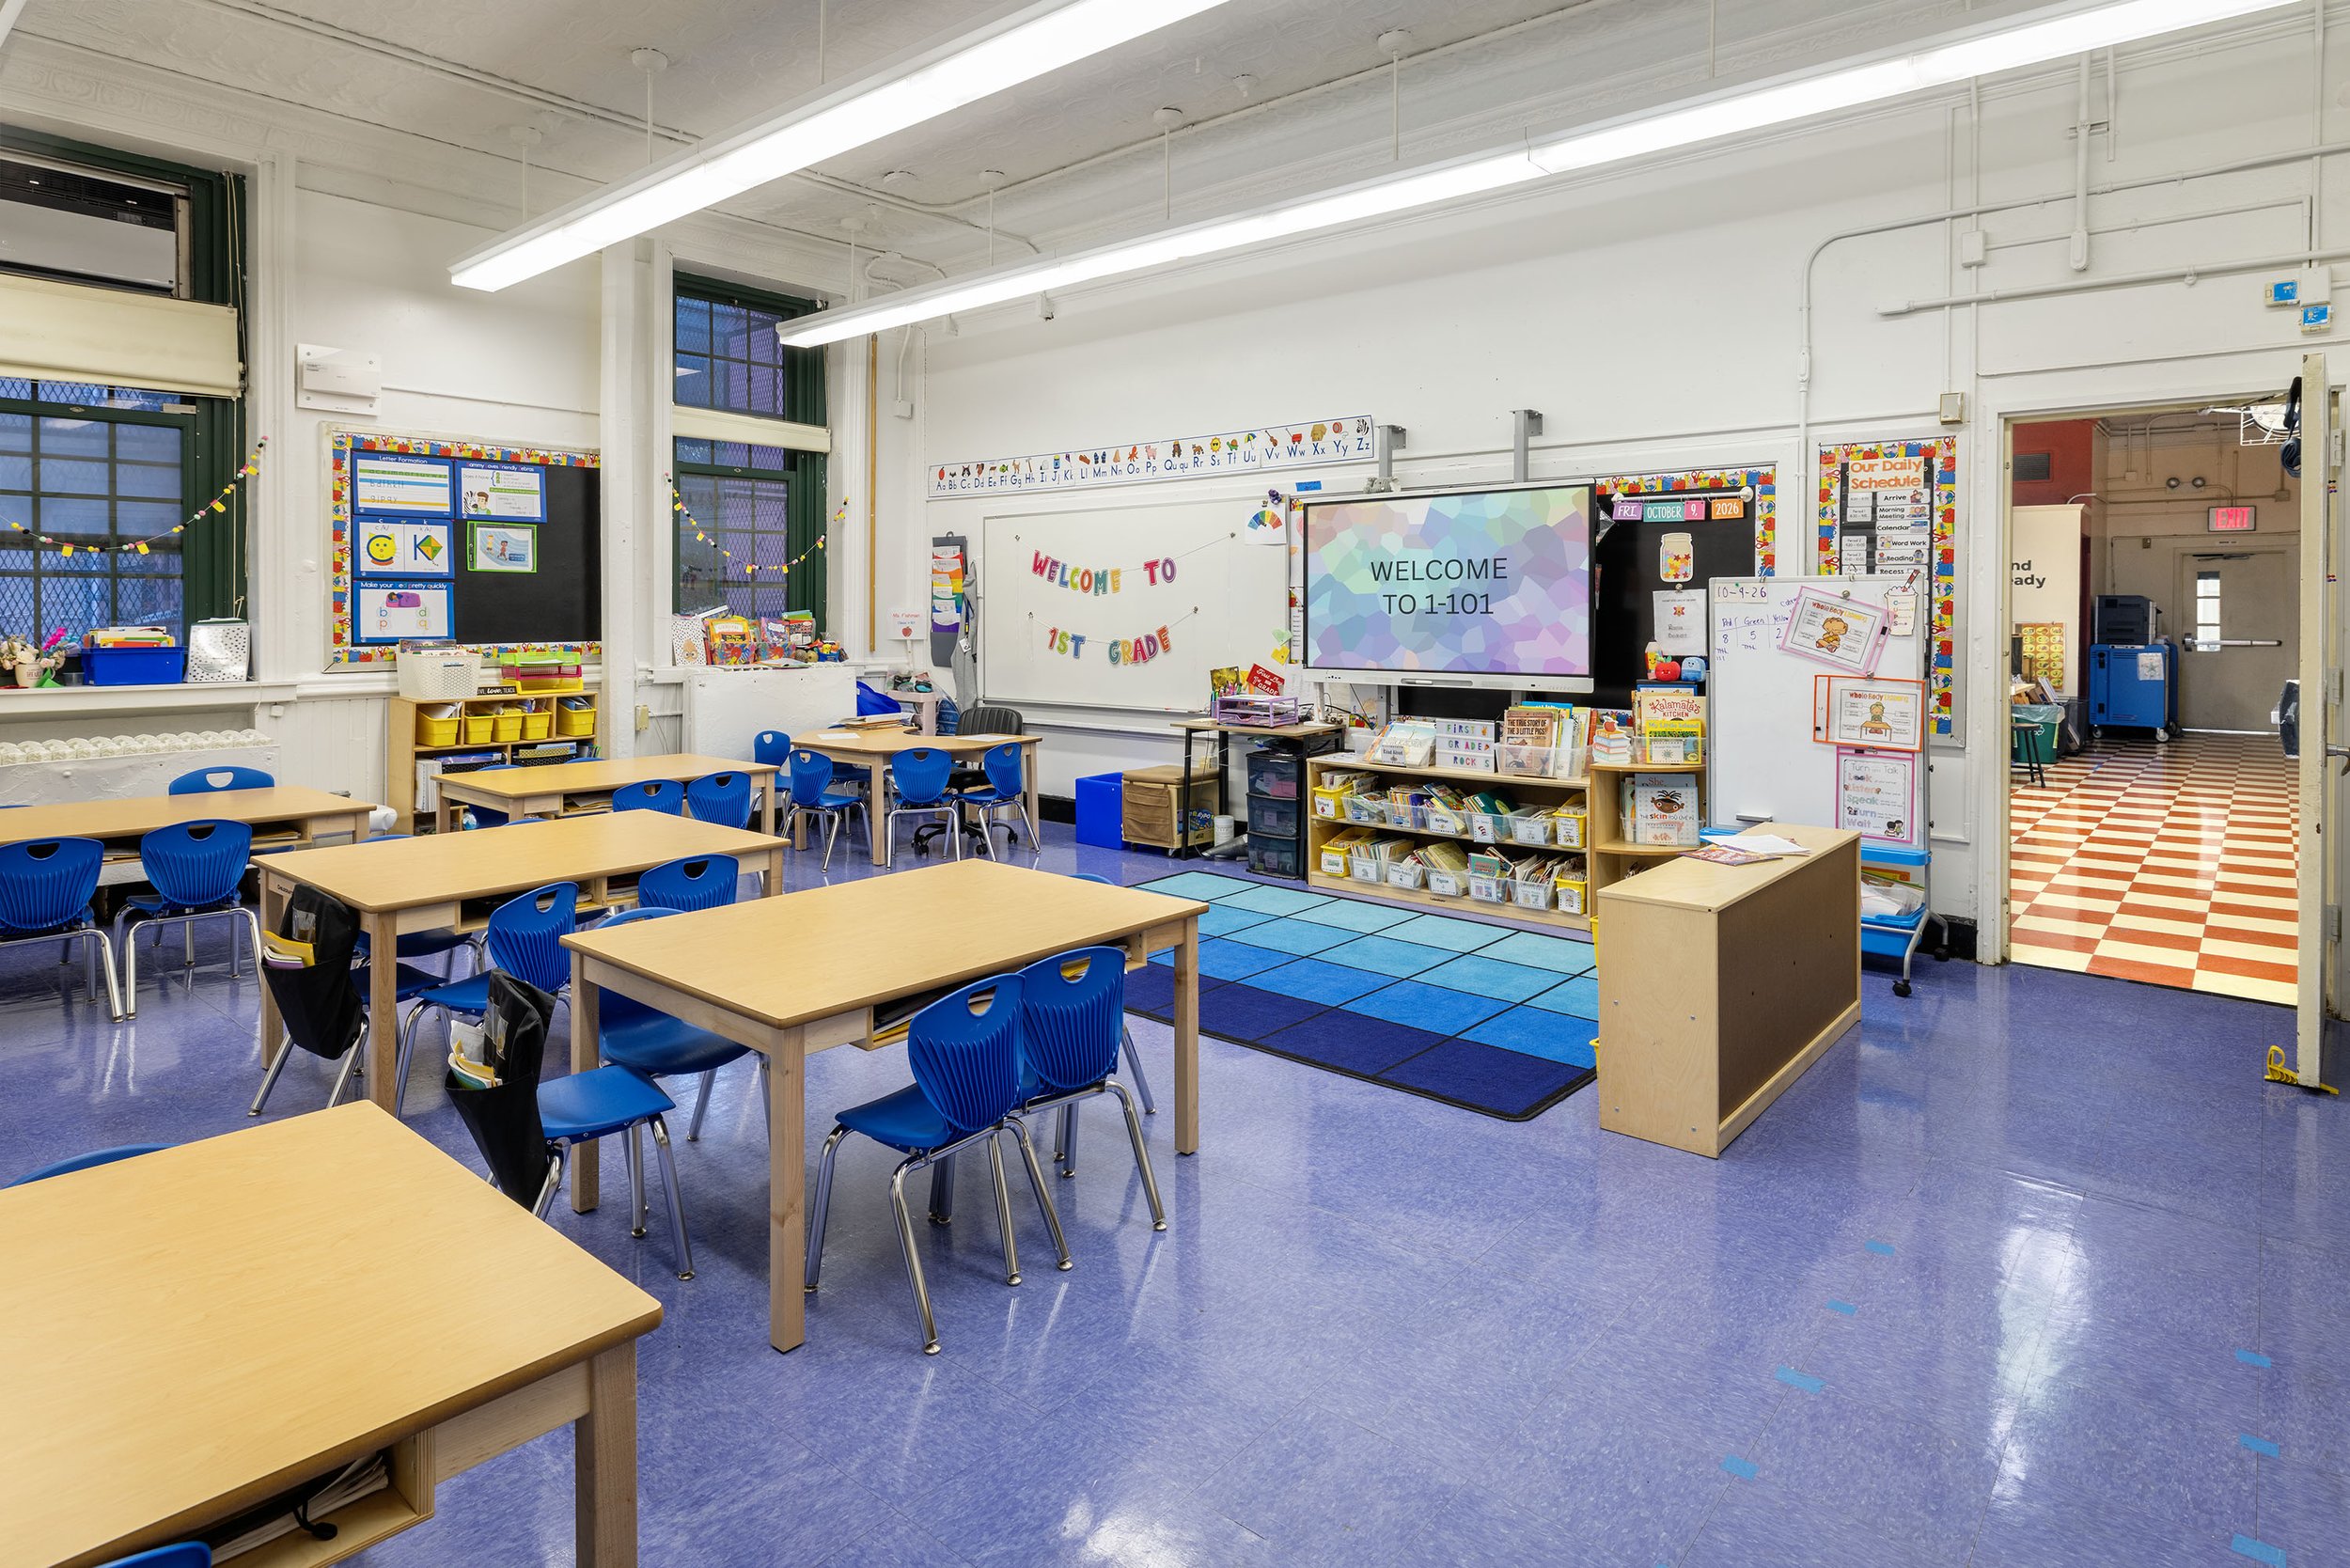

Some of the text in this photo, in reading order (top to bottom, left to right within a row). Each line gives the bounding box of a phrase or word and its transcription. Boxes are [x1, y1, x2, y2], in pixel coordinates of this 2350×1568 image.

[936, 481, 946, 491] Aa
[948, 480, 957, 490] Bb
[960, 478, 971, 489] Cc
[974, 478, 985, 488] Dd
[988, 477, 996, 487] Ee
[999, 476, 1008, 486] Ff
[1010, 475, 1022, 488] Gg
[1025, 473, 1035, 484] Hh
[1041, 472, 1047, 482] Ii
[1052, 470, 1060, 484] Jj
[1064, 469, 1073, 480] Kk
[1081, 468, 1089, 479] Ll
[1092, 467, 1107, 478] Mm
[1110, 464, 1122, 477] Nn
[1126, 463, 1140, 475] Oo
[1146, 461, 1157, 477] Pp
[1193, 456, 1204, 468] Rr
[1210, 454, 1221, 466] Ss
[1227, 452, 1237, 464] Tt
[1243, 450, 1256, 463] Uu
[1265, 447, 1280, 460] Vv
[1286, 445, 1306, 458] Ww
[1312, 442, 1325, 456] Xx
[1333, 440, 1349, 457] Yy
[1356, 437, 1371, 451] Zz
[1850, 459, 1923, 473] Our Daily
[1851, 475, 1921, 490] Schedule
[1618, 502, 1740, 519] FRI. OCTOBER 9, 2026
[2216, 508, 2249, 528] EXIT
[1031, 549, 1177, 597] WELCOME TO
[1371, 557, 1508, 582] WELCOME
[427, 583, 447, 591] quickly
[2012, 573, 2046, 589] ady
[1383, 593, 1494, 615] TO 1-101
[1811, 601, 1829, 612] Whole
[1829, 605, 1844, 617] Body
[379, 606, 427, 618] b d
[379, 619, 388, 632] p
[1744, 617, 1765, 626] Green
[1722, 634, 1729, 644] 8
[1749, 630, 1757, 640] 5
[1776, 627, 1782, 639] 2
[1048, 624, 1171, 665] 1ST GRADE
[1257, 682, 1278, 696] GRADE
[1848, 691, 1868, 699] Whole
[1868, 692, 1884, 701] Body
[1649, 698, 1701, 714] Kalamata's
[1851, 762, 1871, 772] Turn
[1648, 776, 1664, 787] She
[1846, 794, 1879, 806] Speak
[1846, 818, 1872, 828] Wait
